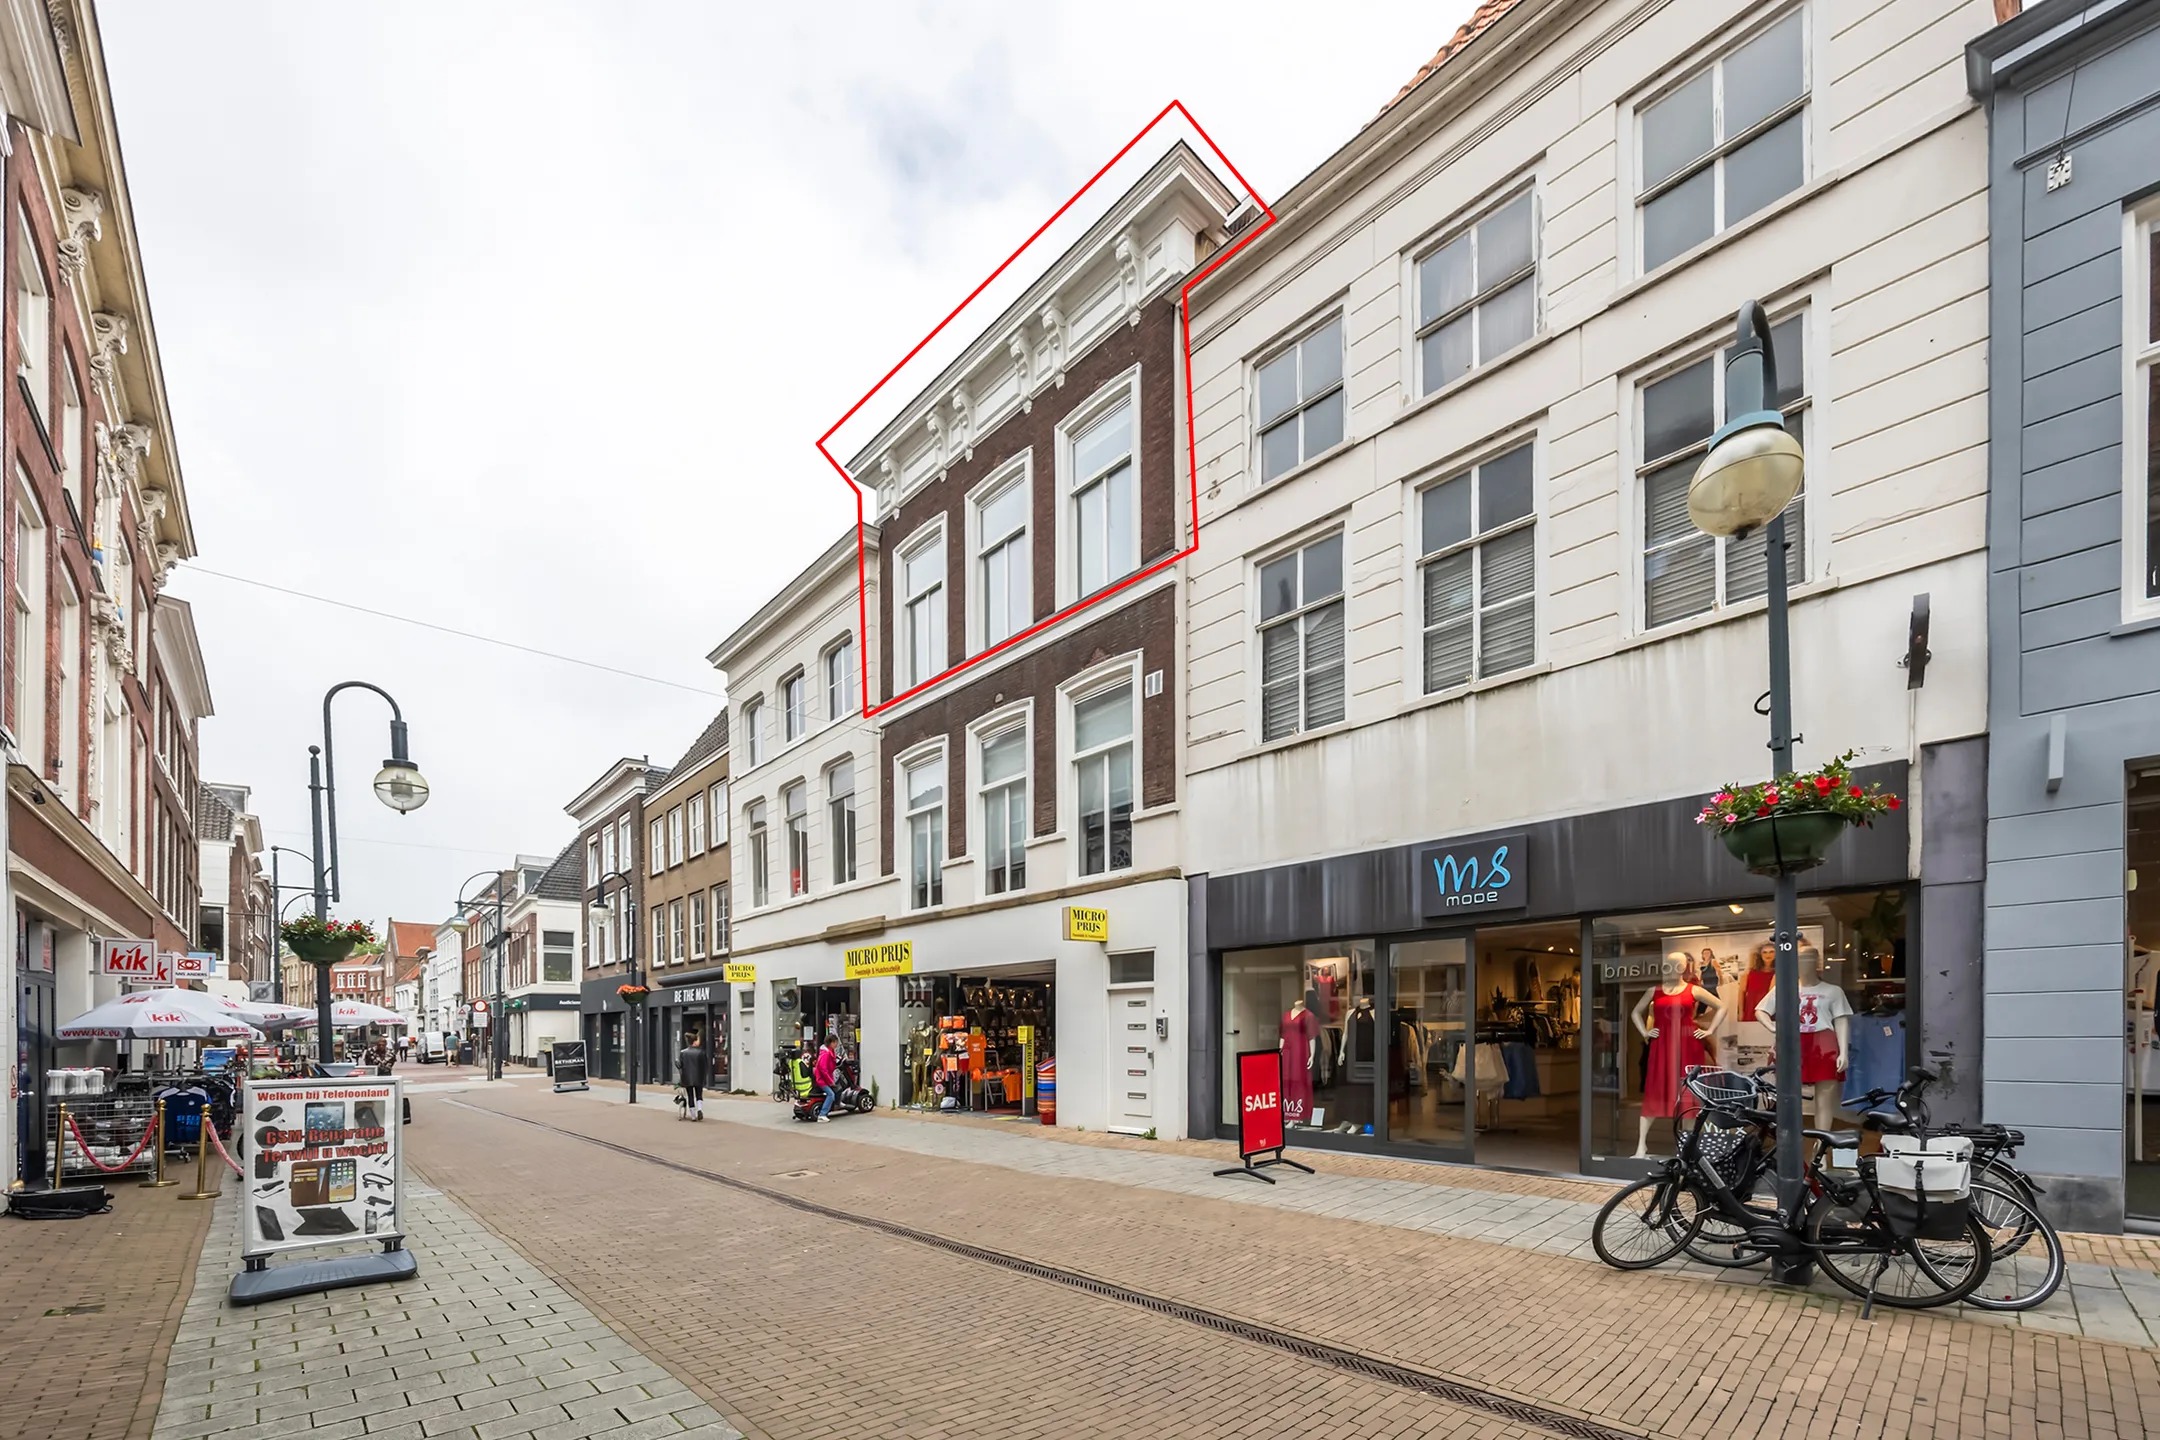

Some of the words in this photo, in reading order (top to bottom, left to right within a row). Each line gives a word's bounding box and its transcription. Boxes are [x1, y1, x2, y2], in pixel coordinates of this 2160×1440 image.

[1072, 909, 1106, 922] MICRO
[1076, 921, 1101, 932] PRIJS
[1779, 943, 1792, 951] 10
[109, 944, 149, 971] kik
[847, 947, 878, 967] MICRO
[881, 943, 910, 963] PRIJS
[674, 990, 682, 1003] BE
[683, 988, 695, 1002] THE
[695, 986, 710, 1001] MAN
[151, 1012, 181, 1022] kik
[62, 1029, 121, 1038] www.kik.eu
[257, 1092, 303, 1101] Welkom
[305, 1090, 320, 1100] bij
[322, 1089, 389, 1099] Telefoonland
[1245, 1092, 1276, 1112] SALE
[308, 1126, 385, 1143] Reparatie
[263, 1146, 319, 1163] Terwijl
[322, 1147, 333, 1159] u
